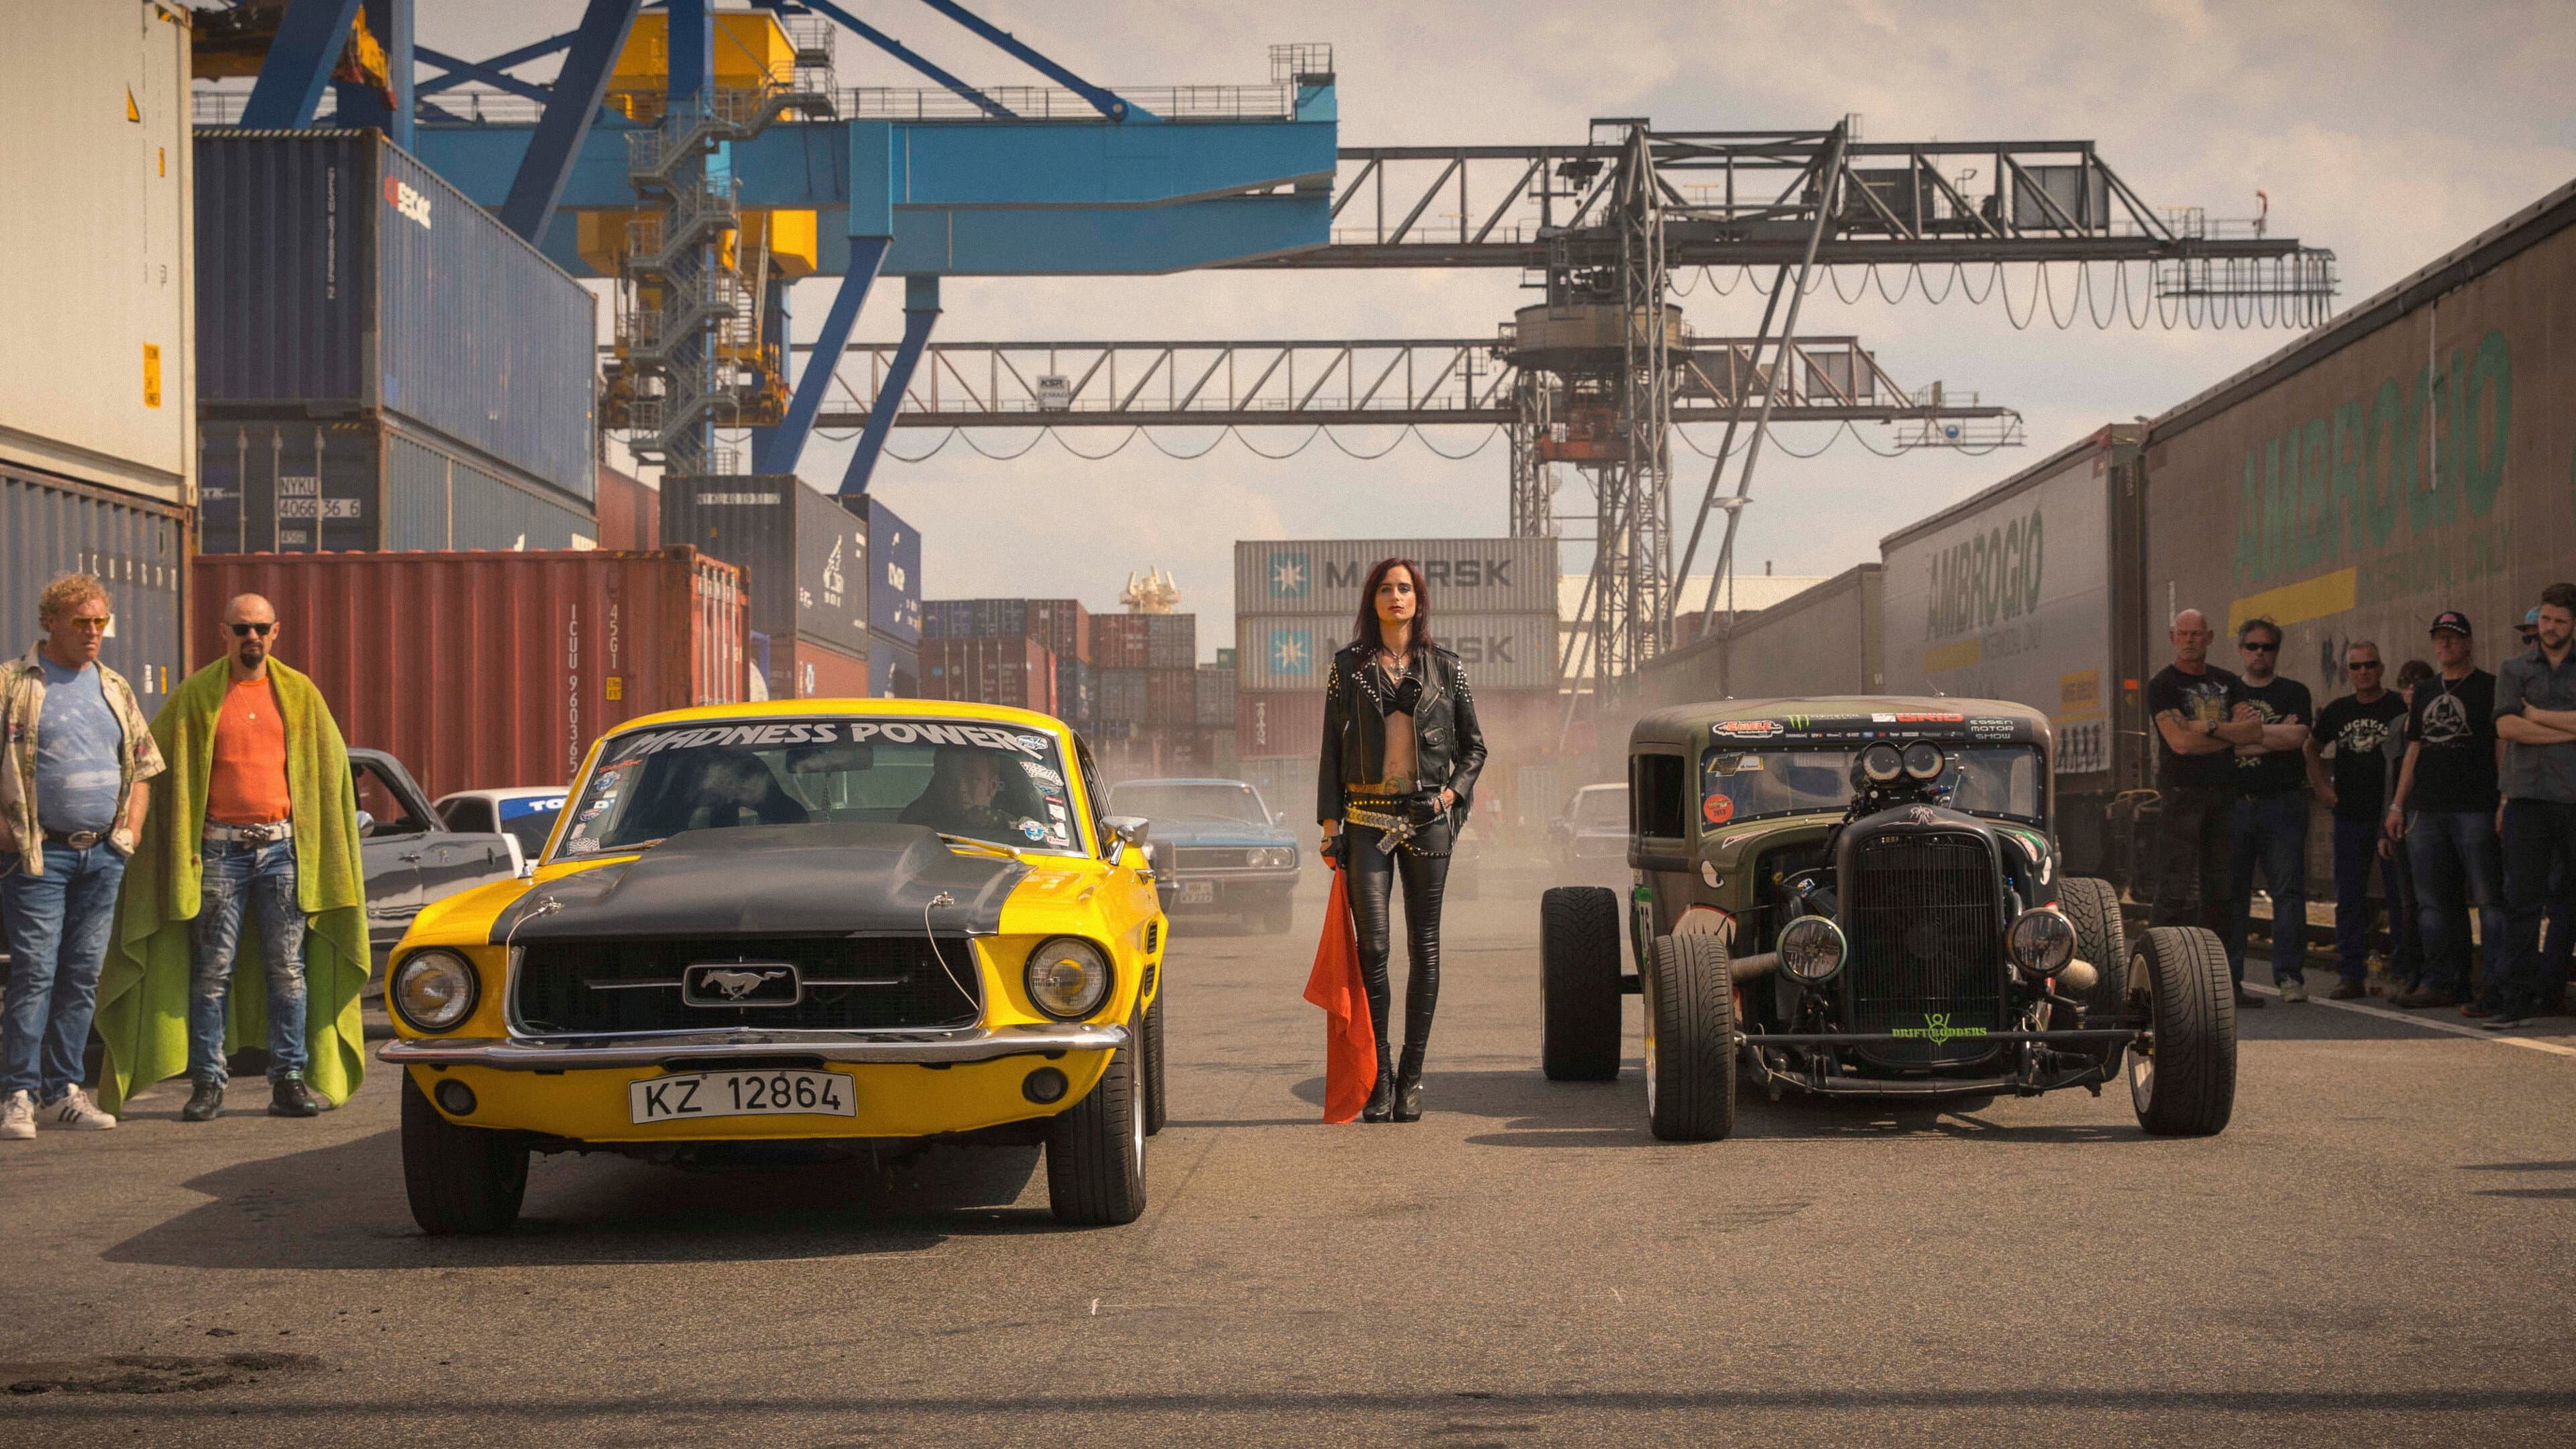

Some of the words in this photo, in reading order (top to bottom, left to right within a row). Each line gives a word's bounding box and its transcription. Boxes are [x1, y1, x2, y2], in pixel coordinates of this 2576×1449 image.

[282, 478, 317, 494] NYKU
[2233, 327, 2513, 588] AMBROGIO
[1326, 559, 1512, 588] MRSK
[1925, 508, 2043, 642] AMBROGIO
[569, 604, 578, 669] ICUU
[609, 604, 619, 669] 45G1
[569, 676, 578, 773] 960365
[611, 722, 838, 763] MADNESS
[850, 722, 1044, 760] POWER
[645, 1079, 702, 1117] KZ
[727, 1076, 841, 1111] 12864
